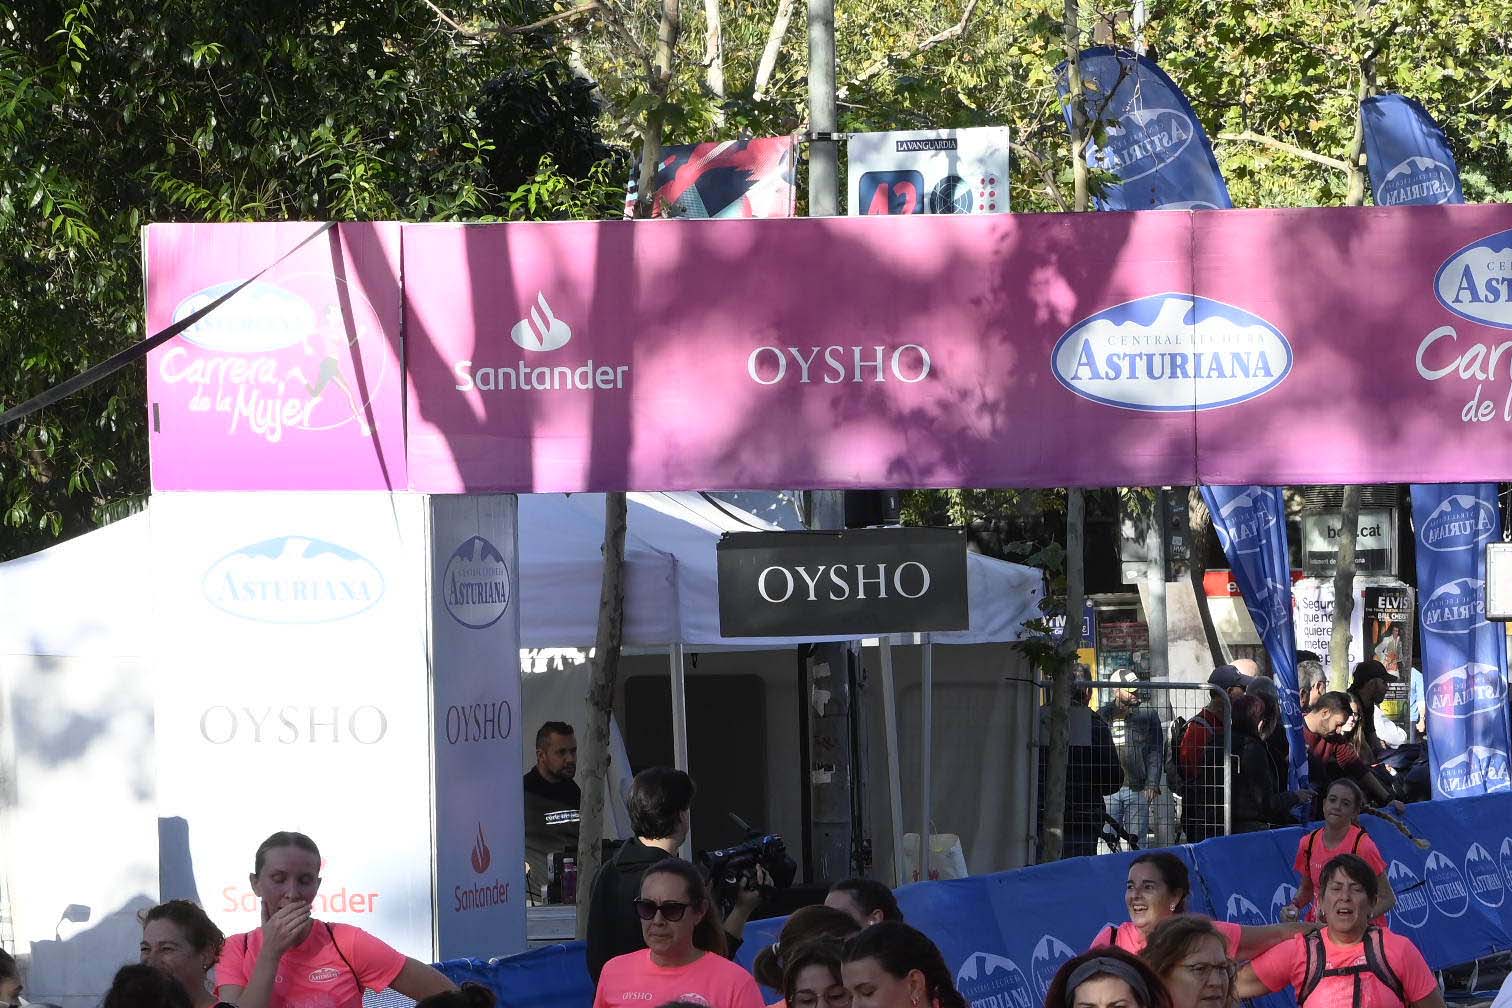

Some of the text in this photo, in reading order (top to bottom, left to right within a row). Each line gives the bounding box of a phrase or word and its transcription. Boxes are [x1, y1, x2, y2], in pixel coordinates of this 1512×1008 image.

[159, 346, 279, 386] Carrera
[455, 359, 628, 392] Santander
[746, 343, 931, 385] OYSHO
[1071, 339, 1273, 382] ASTURIANA
[229, 386, 320, 442] Mujer
[1461, 384, 1496, 423] de
[447, 569, 508, 607] ASTURIANA
[757, 560, 931, 604] OYSHO
[199, 704, 388, 746] OYSHO
[445, 699, 513, 746] OYSHO
[453, 879, 511, 914] Santander
